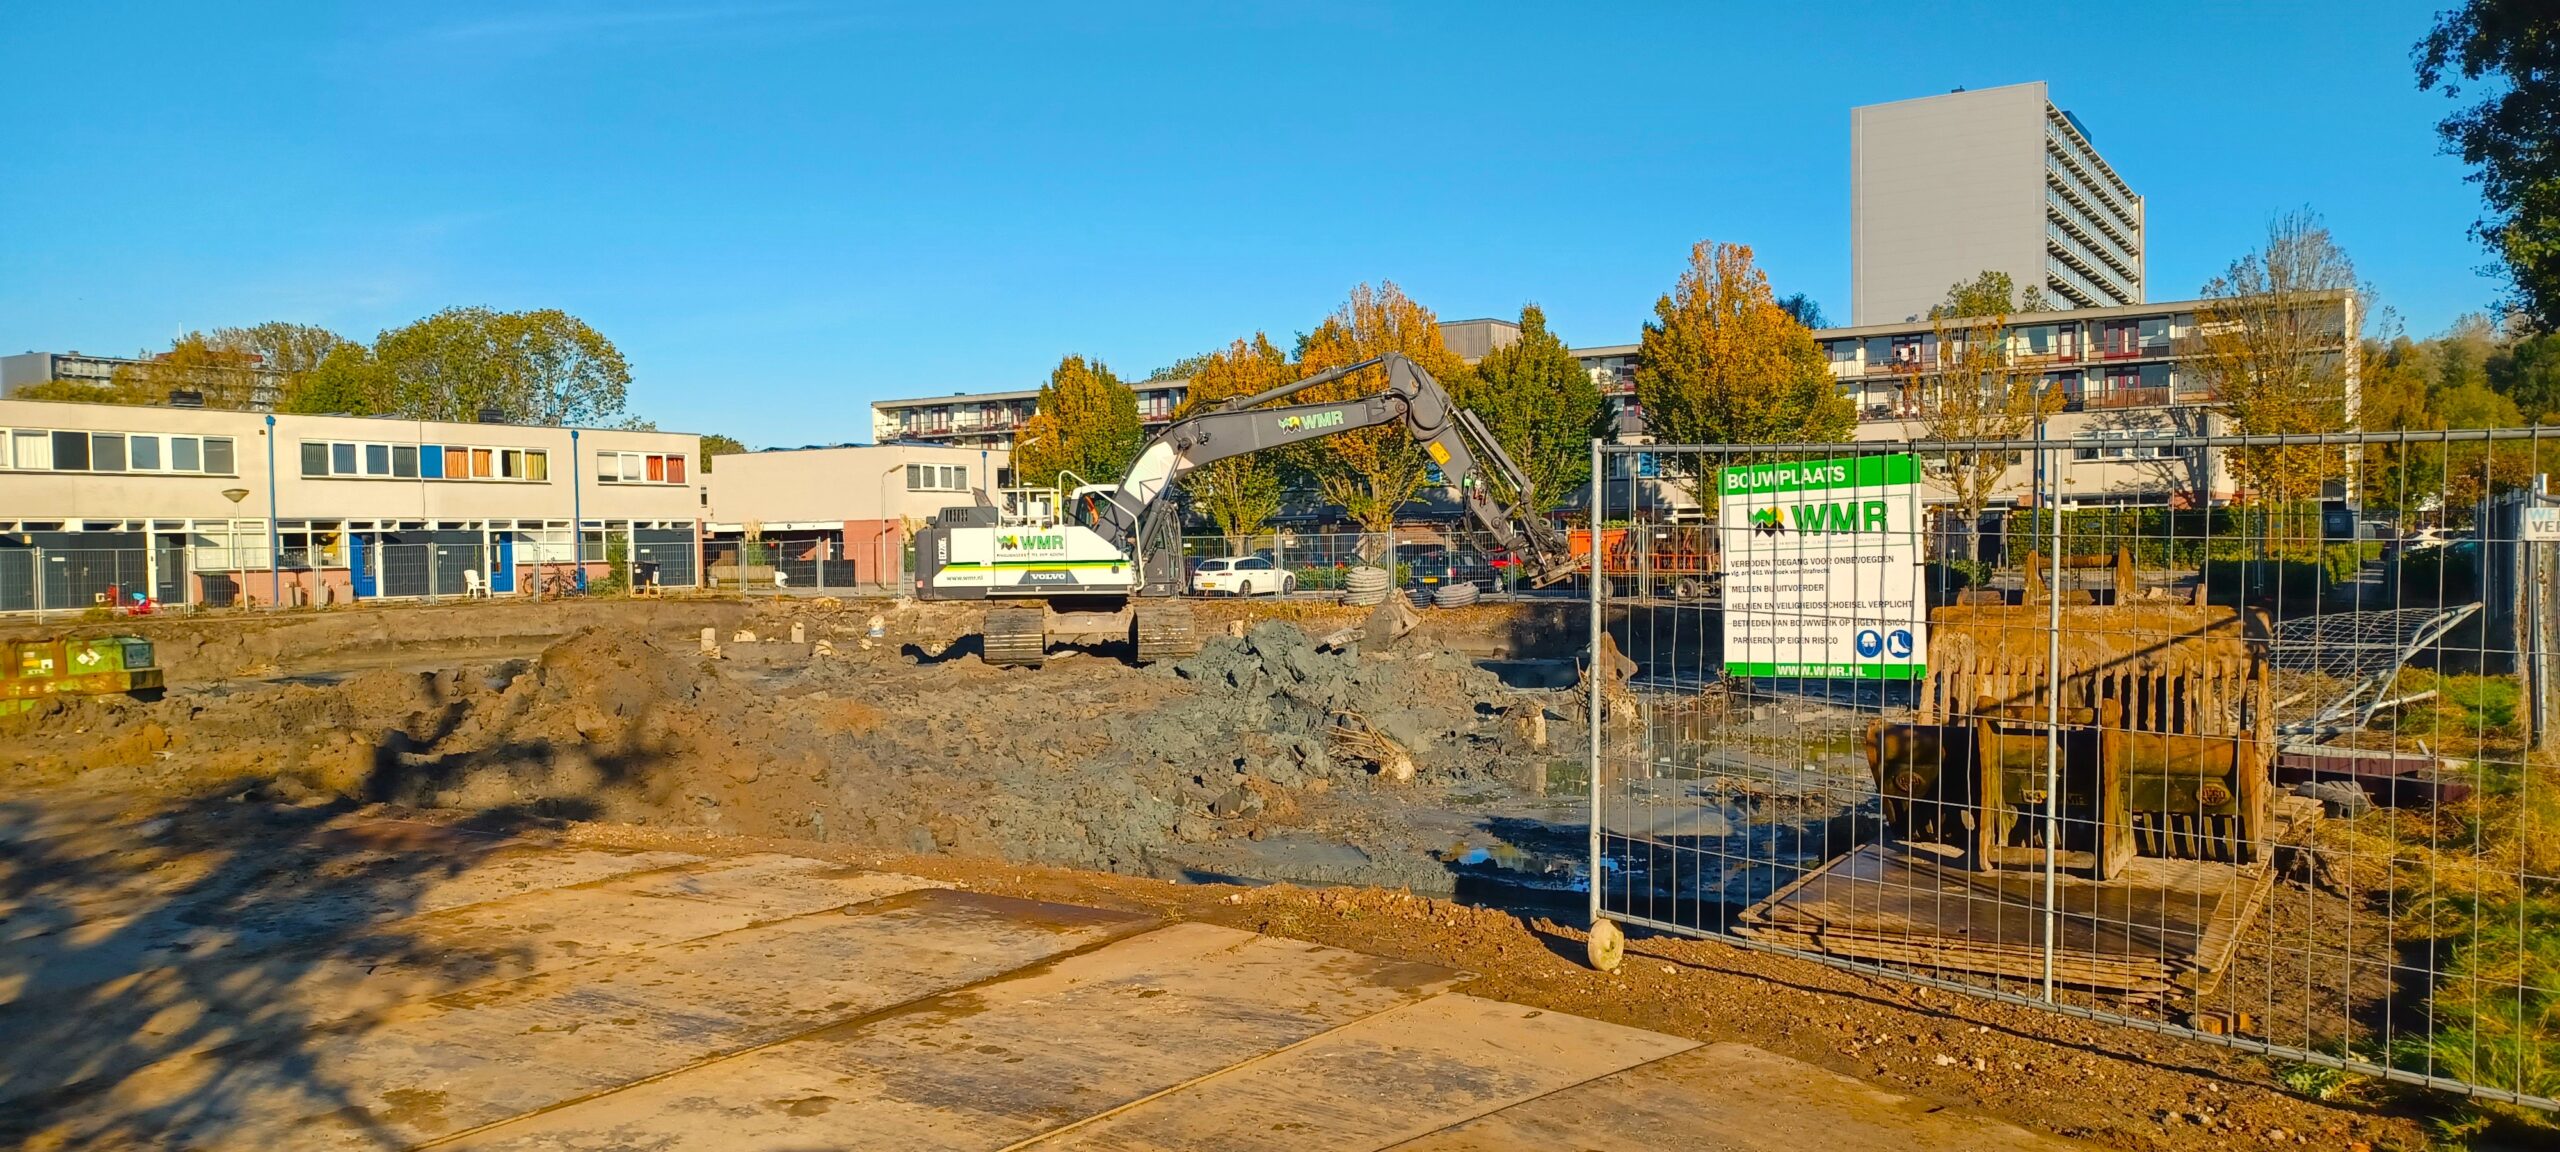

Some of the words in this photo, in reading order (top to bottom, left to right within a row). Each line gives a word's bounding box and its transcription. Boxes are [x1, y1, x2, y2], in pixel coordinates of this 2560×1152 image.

[1300, 410, 1344, 430] WMR
[1727, 466, 1846, 489] BOUWPLAATS
[1791, 500, 1889, 537] WMR
[1020, 535, 1064, 550] WMR
[1730, 559, 1771, 568] VERBODEN
[1810, 557, 1833, 566] VOOR
[1833, 555, 1894, 565] ONBEVOEGDEN
[1732, 585, 1762, 593] MELDEN
[1776, 583, 1825, 592] UITVOERDER
[1732, 602, 1762, 611] HELMEN
[1764, 602, 1775, 610] EN
[1776, 601, 1867, 610] VEILIGHEIDSSCHOEISEL
[1868, 600, 1913, 609] VERPLICHT
[1838, 618, 1851, 627] OP
[1774, 636, 1786, 645] OP
[1787, 636, 1810, 645] EIGEN
[1812, 636, 1839, 645] RISCO
[1775, 664, 1867, 677] WWW.WMR.NL
